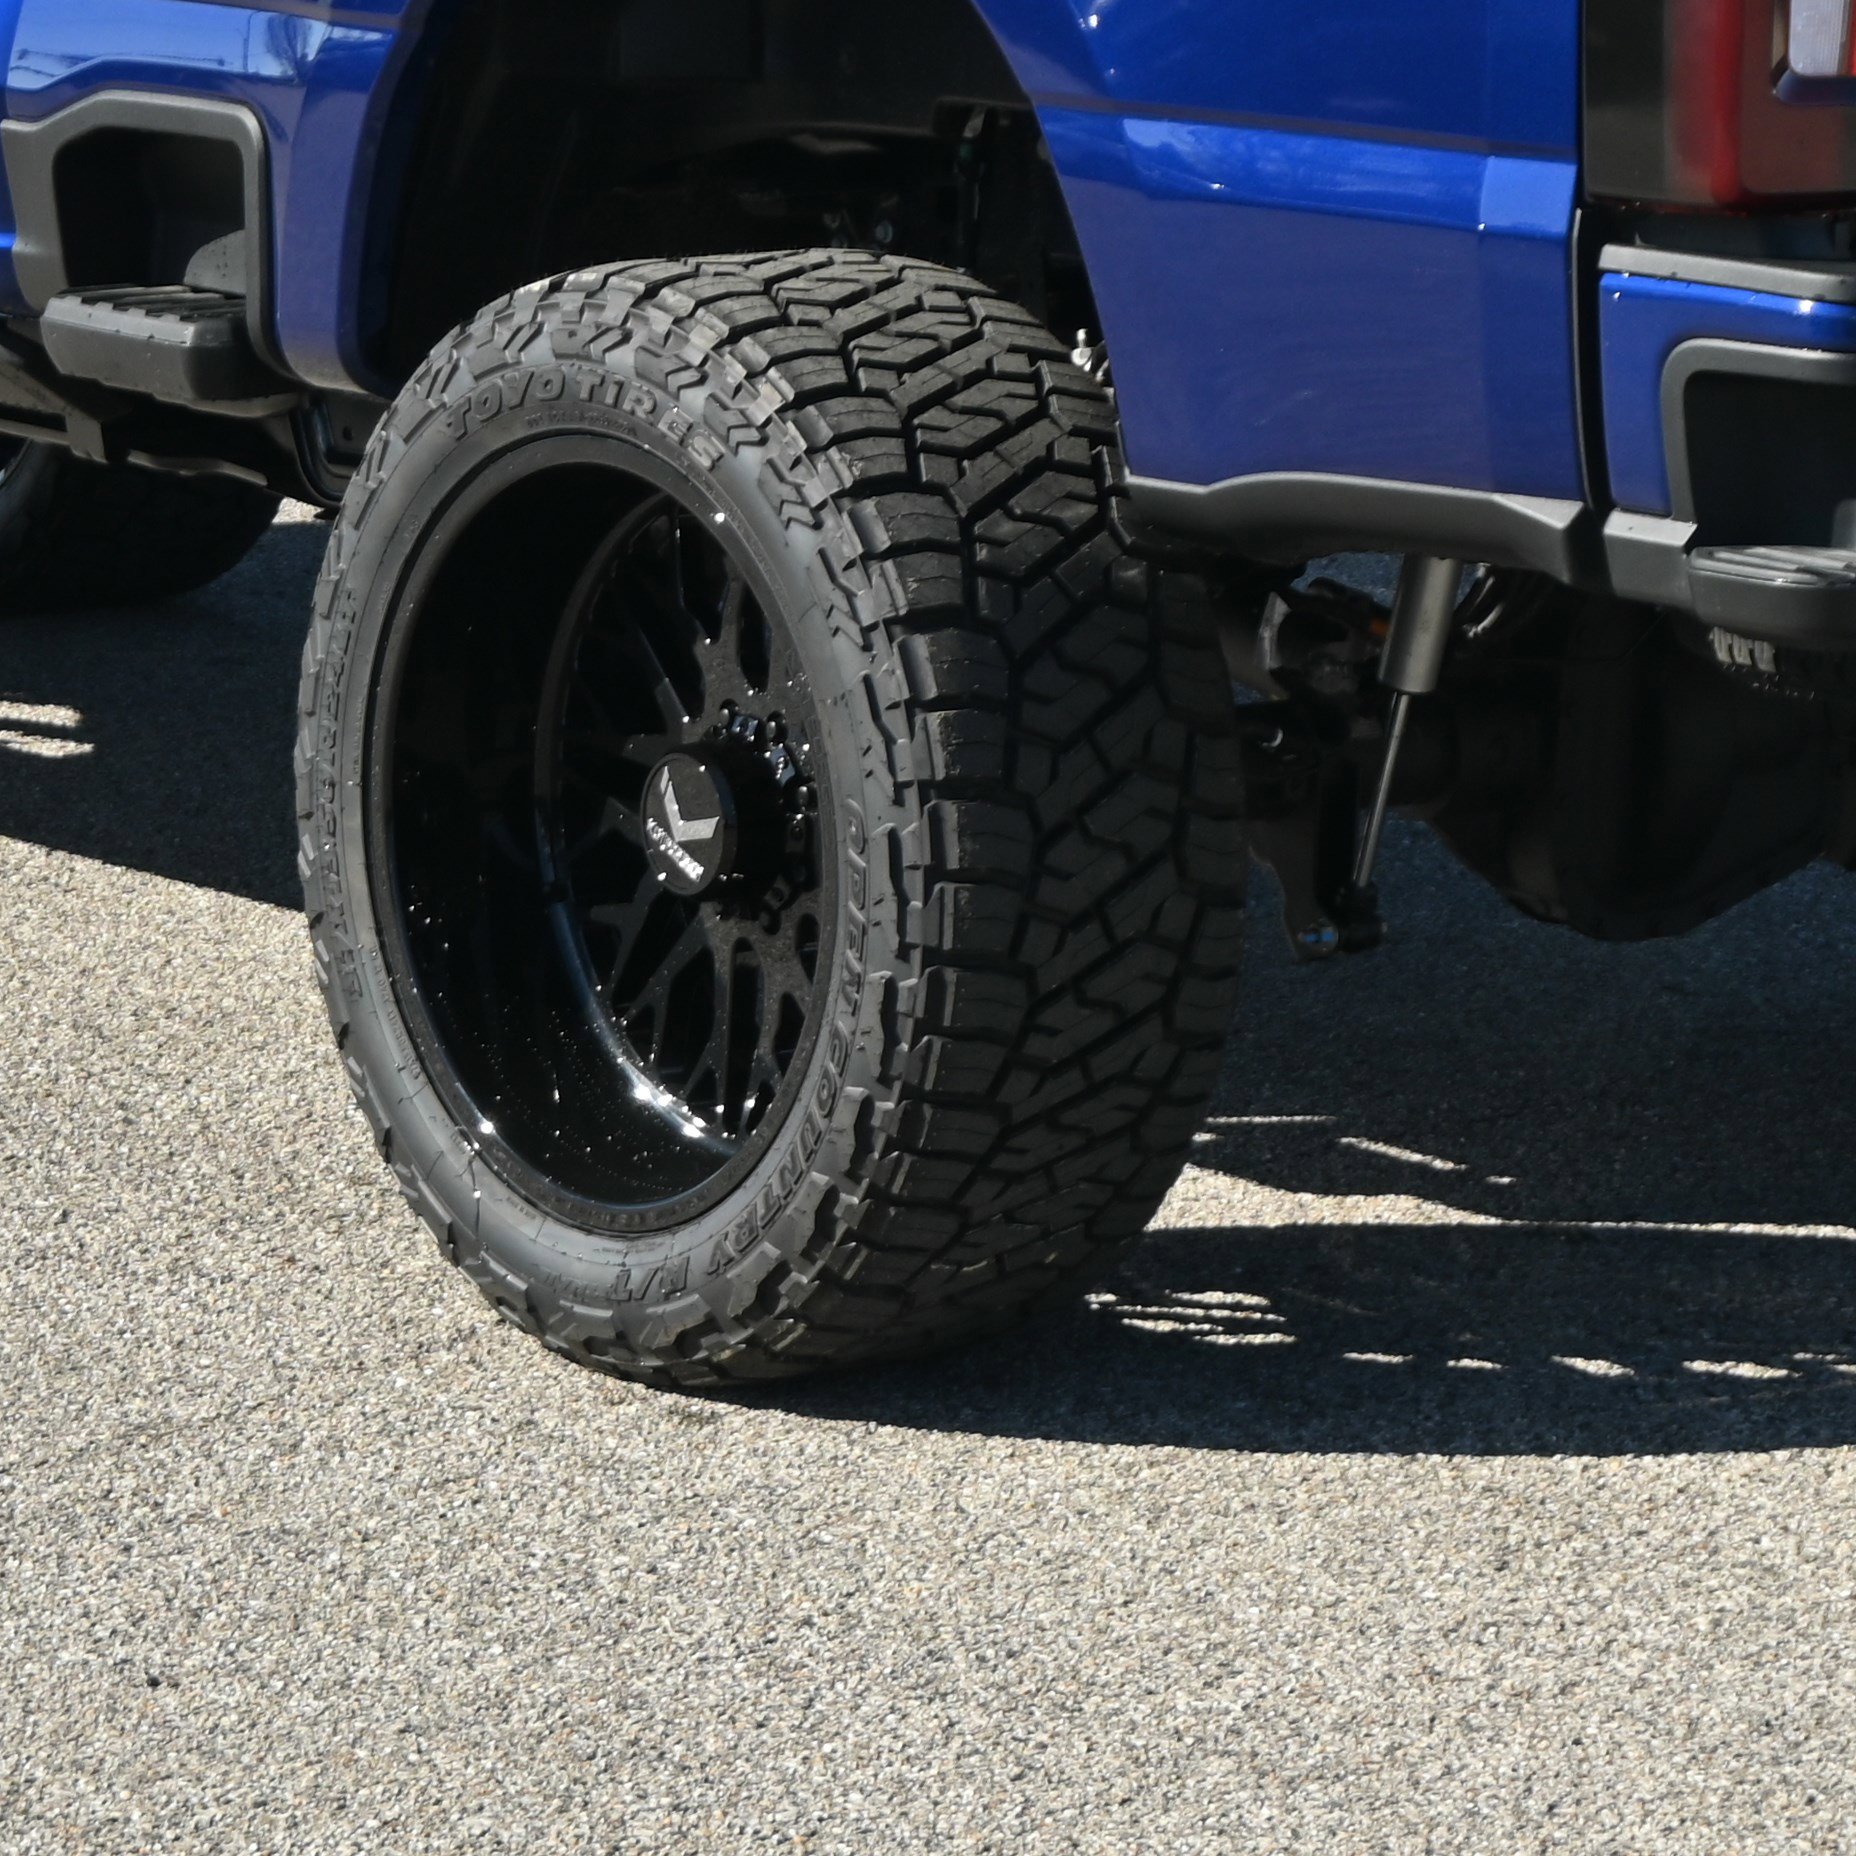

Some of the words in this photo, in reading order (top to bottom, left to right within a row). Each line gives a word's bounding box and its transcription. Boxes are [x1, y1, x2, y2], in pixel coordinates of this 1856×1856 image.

[446, 366, 566, 442] TOYO
[575, 370, 727, 472] TIRES
[843, 797, 867, 1016] OPEN
[707, 1020, 848, 1277] COUNTRY
